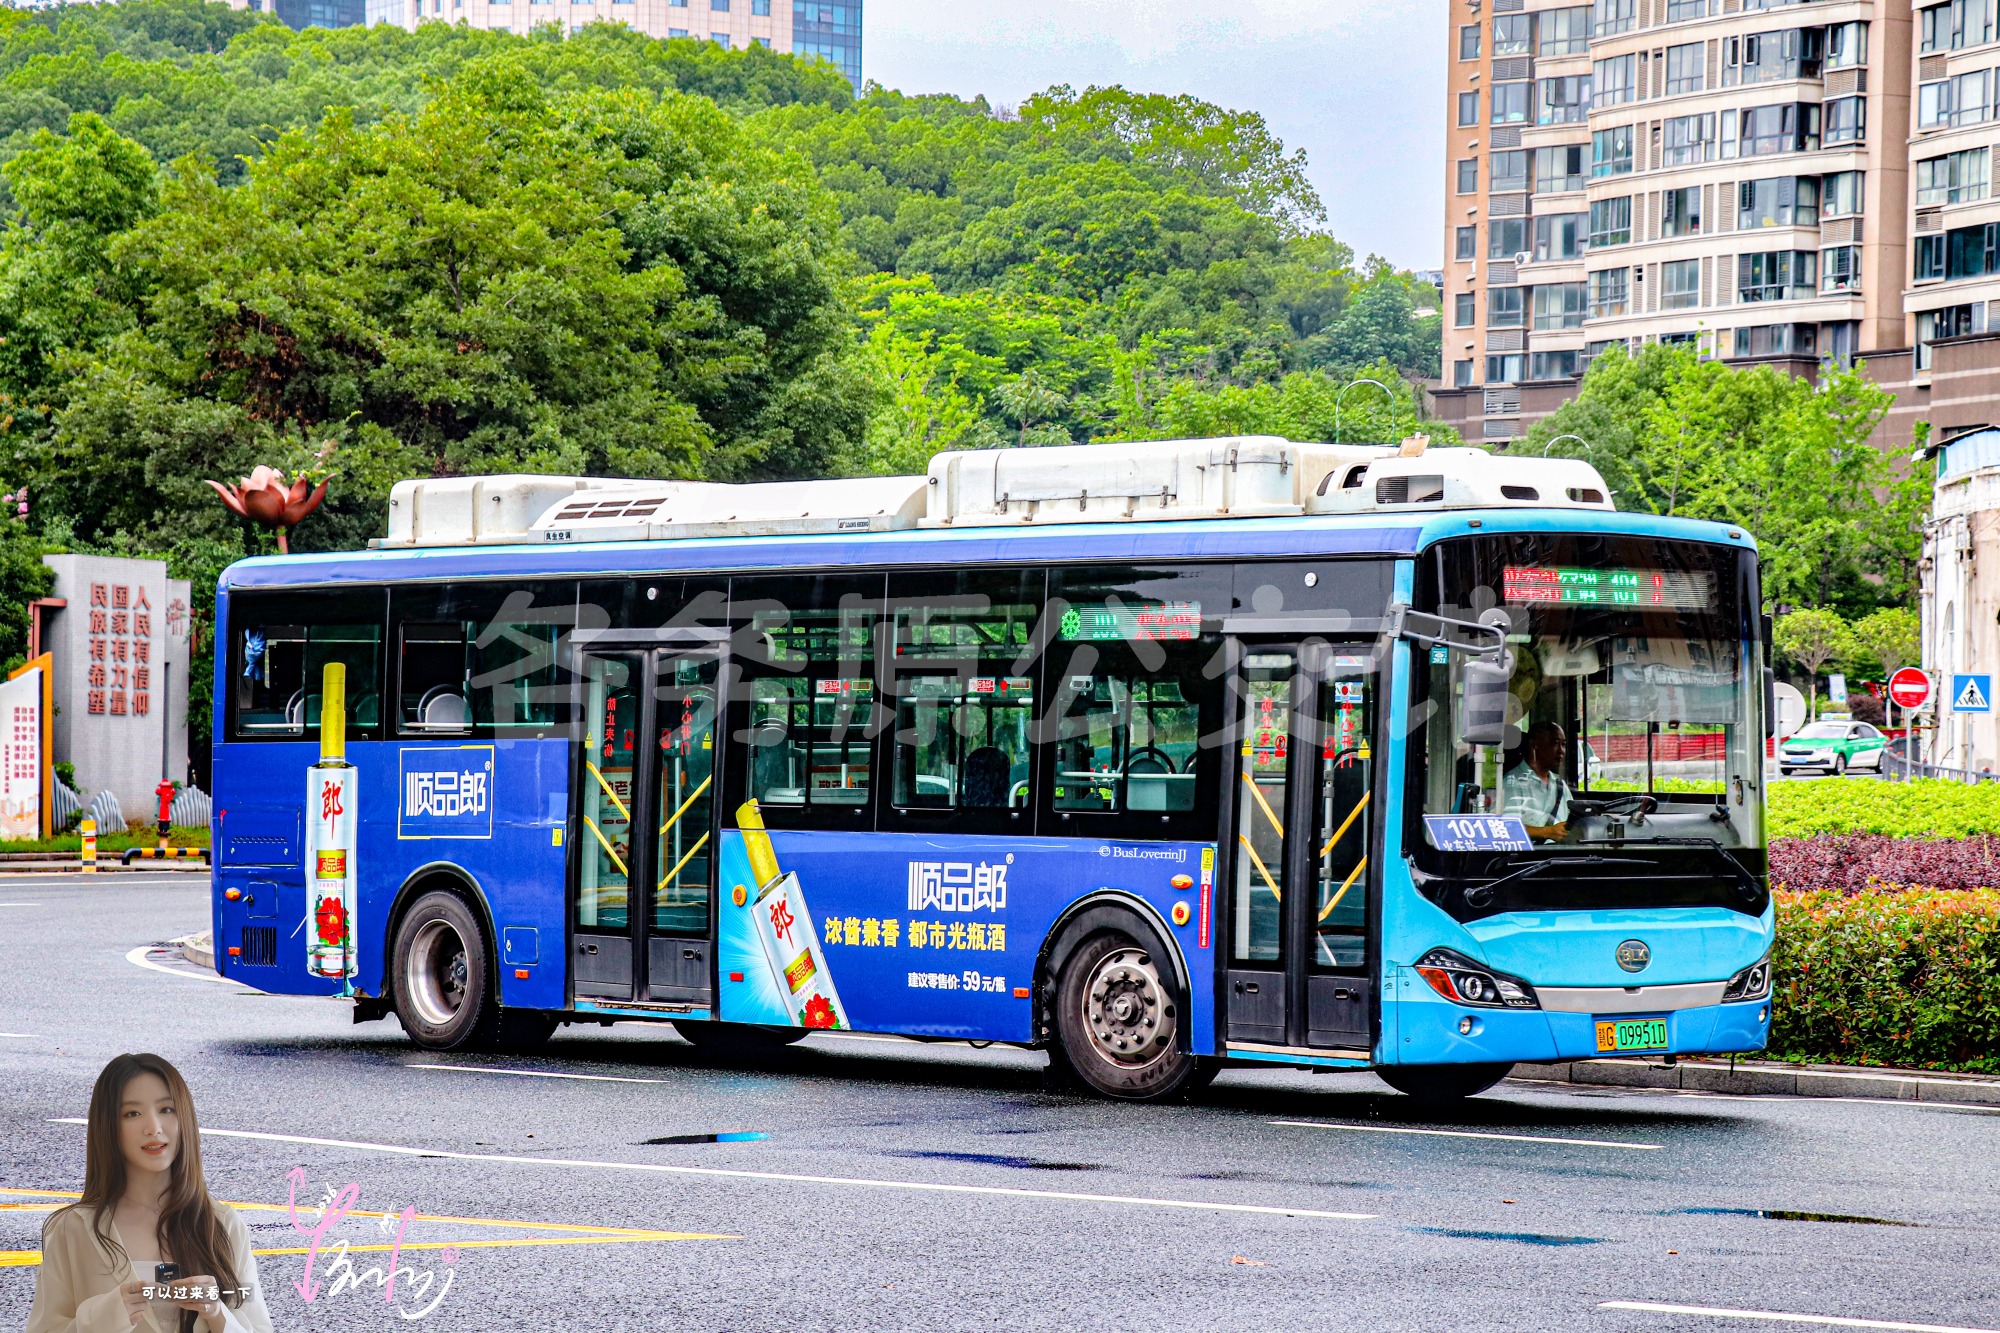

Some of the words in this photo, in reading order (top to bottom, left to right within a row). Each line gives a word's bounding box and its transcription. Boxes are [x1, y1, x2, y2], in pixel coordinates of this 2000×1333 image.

[88, 582, 108, 715] 民族有希望
[110, 584, 129, 716] 国家有力量
[132, 585, 151, 716] 人民有信仰
[824, 916, 900, 947] 浓酱兼香
[908, 919, 1006, 951] 都市光瓶酒
